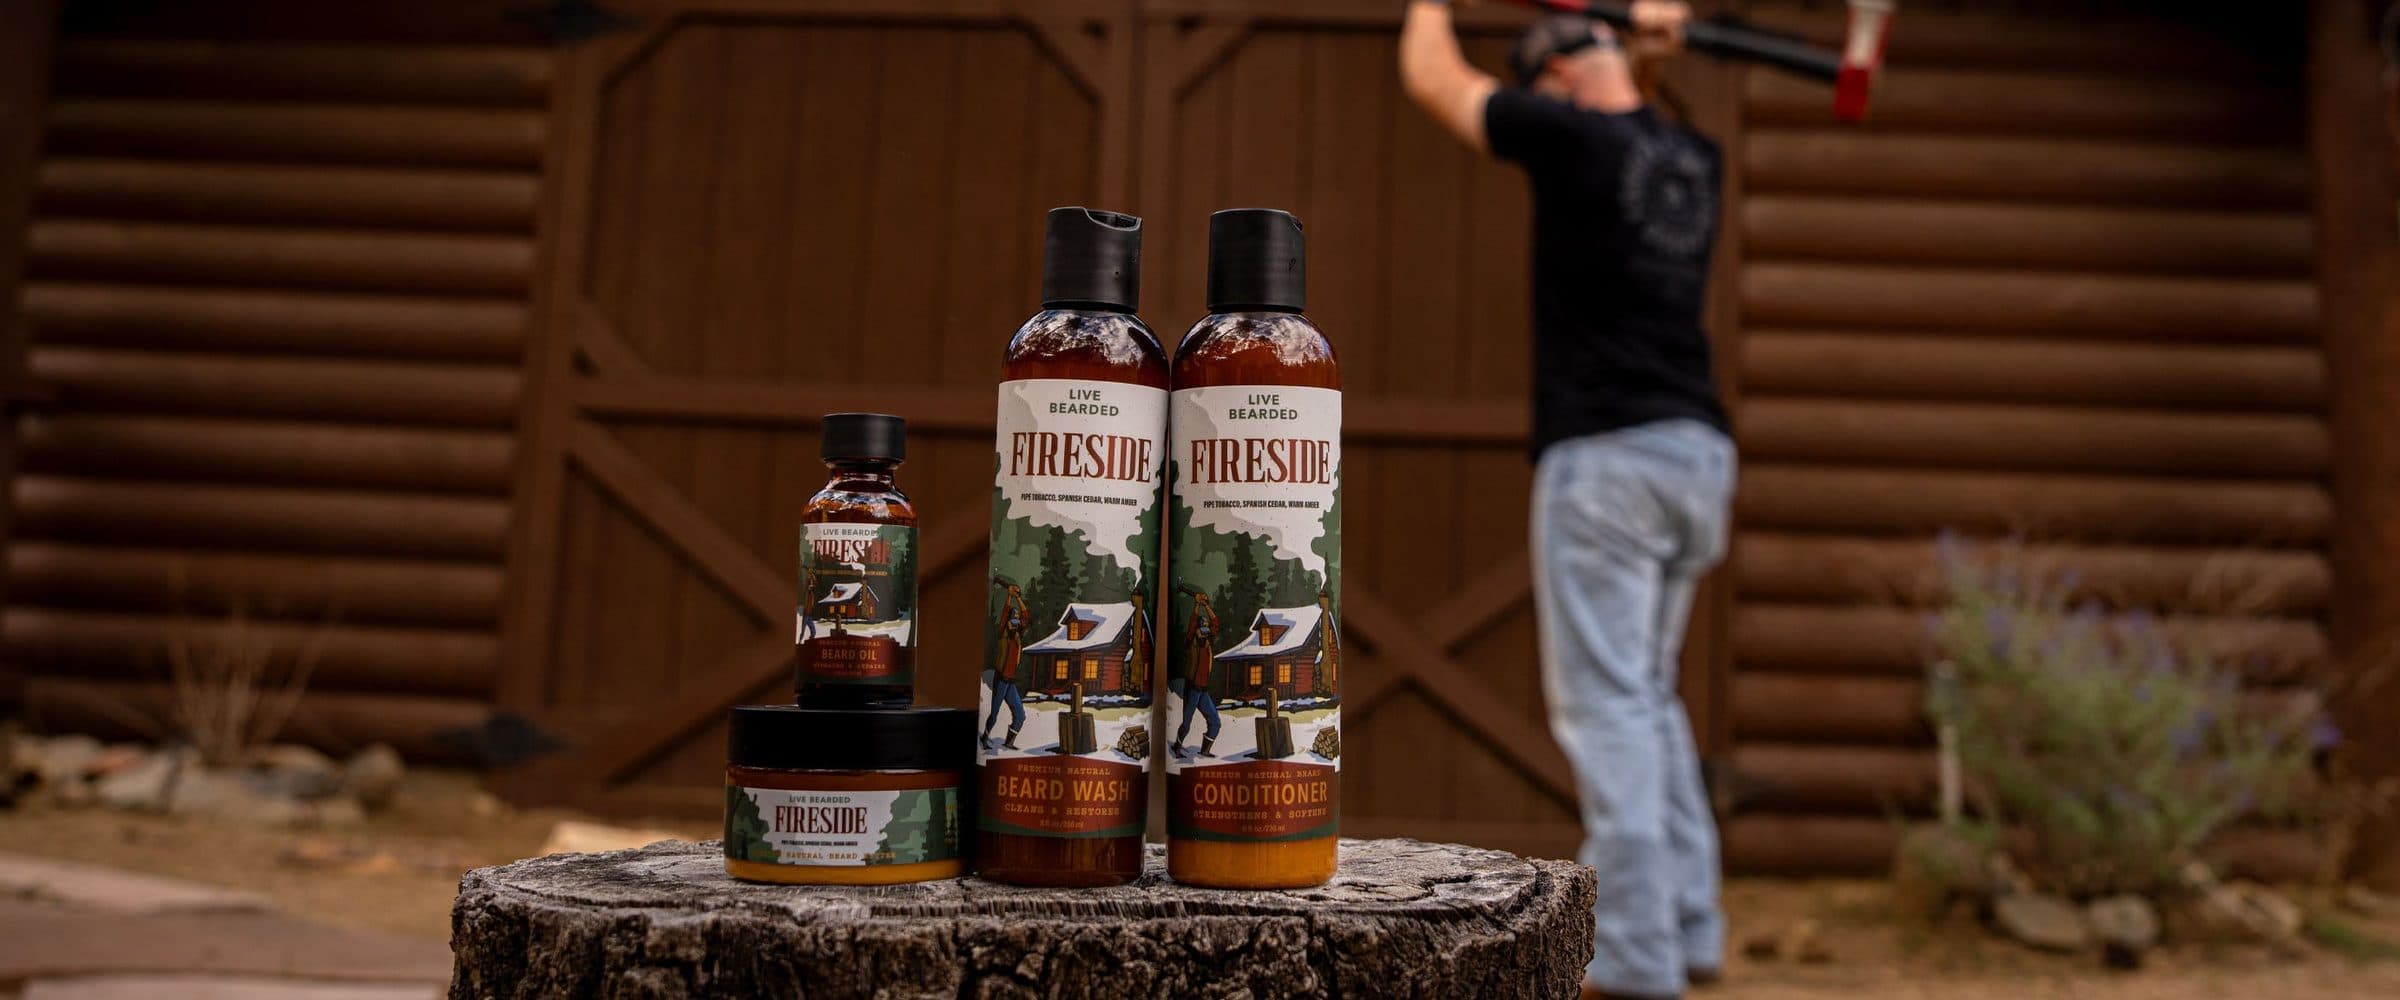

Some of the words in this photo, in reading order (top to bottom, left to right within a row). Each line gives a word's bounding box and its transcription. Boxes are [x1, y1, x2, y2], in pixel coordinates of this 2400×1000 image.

[1069, 389, 1101, 401] LIVE
[1248, 394, 1280, 406] LIVE
[1049, 402, 1120, 416] BEARDED
[1228, 408, 1298, 420] BEARDED
[1010, 432, 1152, 483] FIRESIDE
[1190, 438, 1331, 485] FIRESIDE
[1058, 494, 1083, 503] SPANISH
[1242, 500, 1267, 508] SPANISH
[822, 649, 856, 660] BEARD
[859, 650, 877, 660] OIL
[1066, 767, 1111, 776] NATURAL
[1247, 770, 1292, 779] NATURAL
[998, 775, 1065, 801] BEARD
[1073, 780, 1130, 802] WASH
[1193, 781, 1328, 805] CONDITIONER
[789, 795, 807, 804] LIVE
[809, 795, 851, 804] BEARDED
[1004, 802, 1045, 815] CLEANS
[1066, 807, 1121, 816] RESTORES
[1193, 810, 1268, 820] STRENGTHENS
[774, 805, 868, 835] FIRESIDE
[785, 851, 824, 860] NATURAL
[828, 852, 859, 860] BEARD
